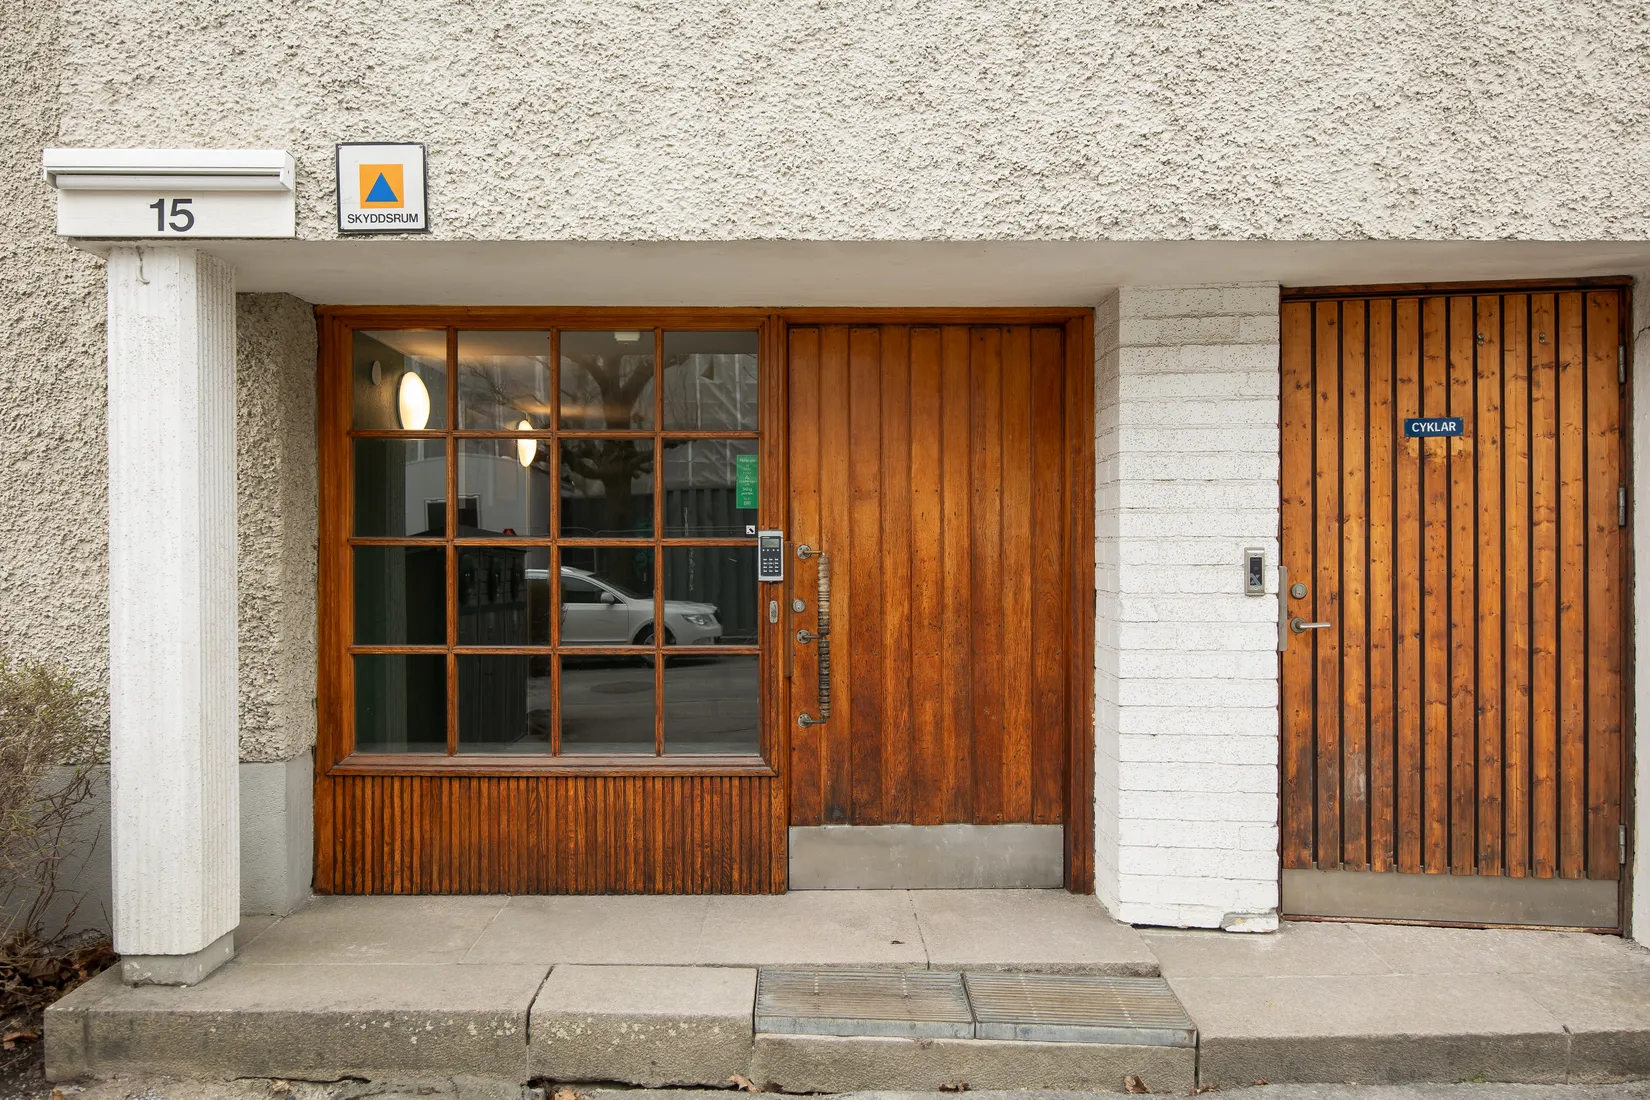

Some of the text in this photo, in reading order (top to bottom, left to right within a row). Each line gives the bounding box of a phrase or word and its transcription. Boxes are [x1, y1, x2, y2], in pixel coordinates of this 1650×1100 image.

[150, 199, 195, 232] 15
[347, 213, 419, 224] SKYDDSRUM
[1411, 421, 1456, 432] CYKLAR
